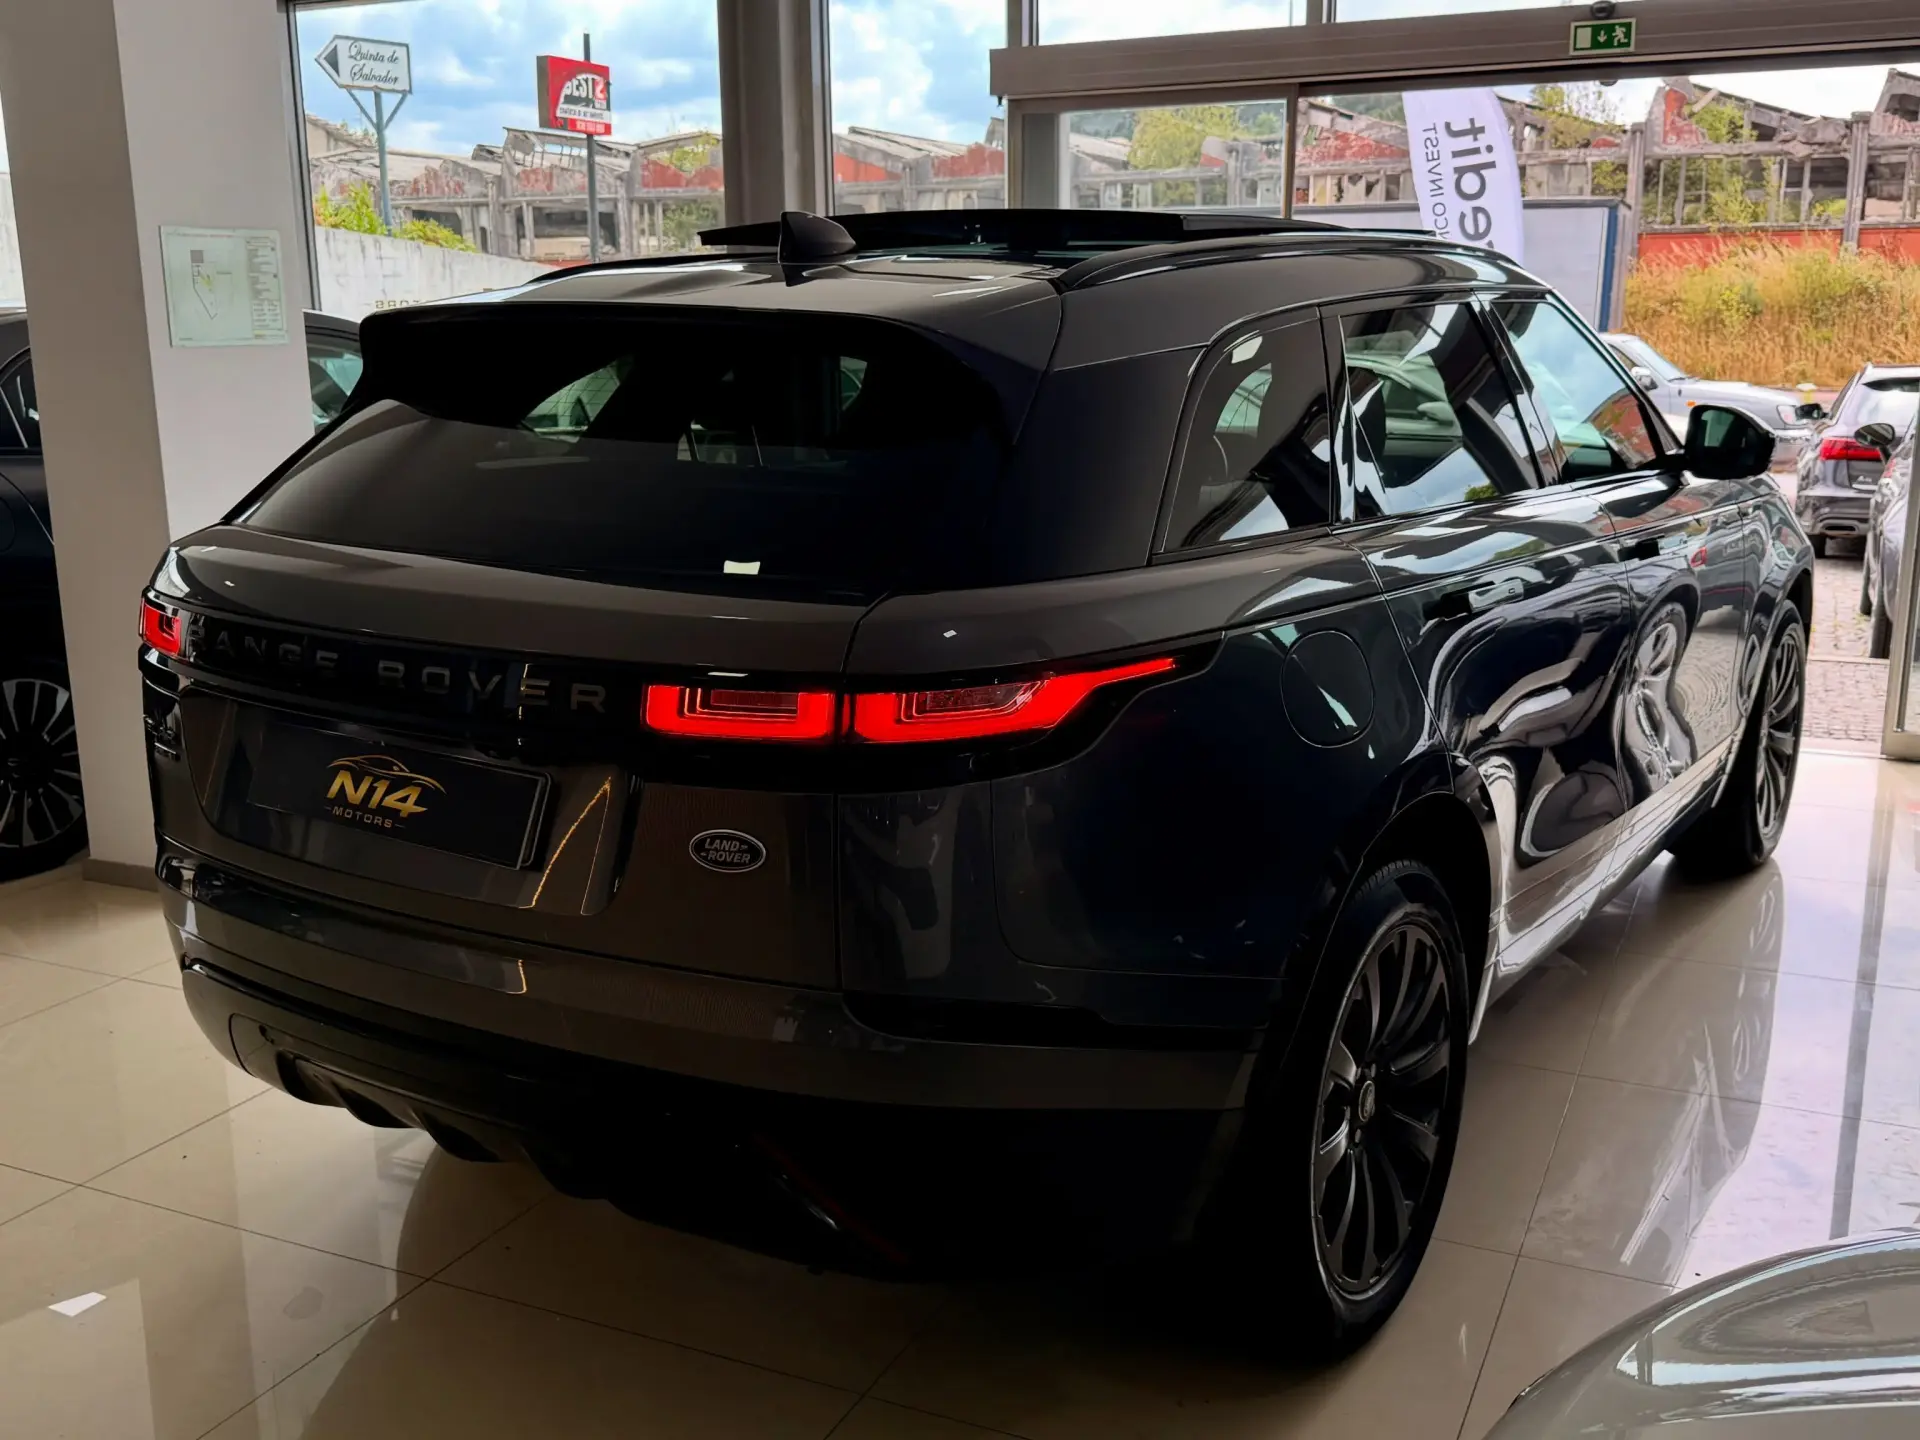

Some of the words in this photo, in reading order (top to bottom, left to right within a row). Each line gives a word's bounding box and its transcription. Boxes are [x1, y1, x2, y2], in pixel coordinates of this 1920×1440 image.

[347, 39, 385, 63] Quinta
[387, 50, 399, 63] de
[349, 63, 400, 86] Salvador
[190, 623, 339, 675] RANGE
[377, 660, 608, 714] ROVER
[326, 768, 428, 818] N14
[332, 805, 393, 828] MOTORS
[704, 838, 740, 851] LAND
[707, 850, 751, 864] ROVER
